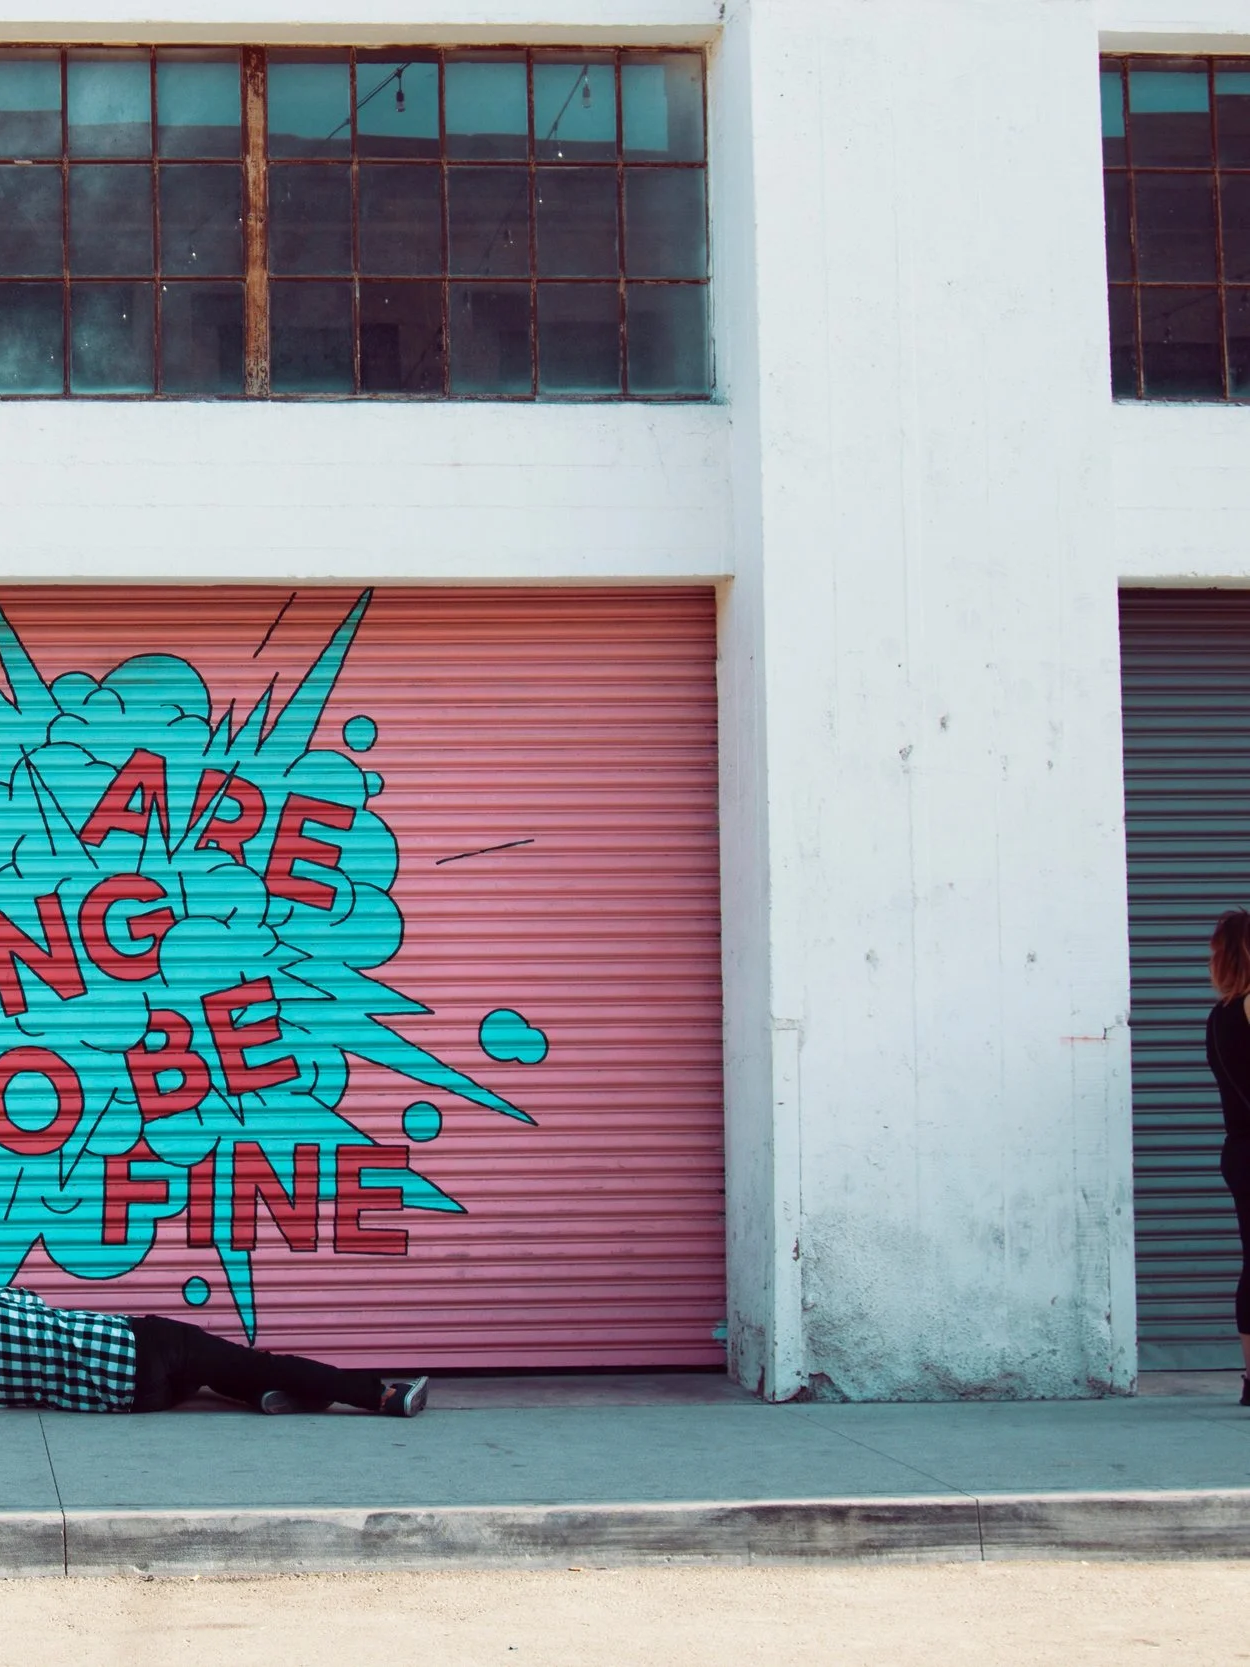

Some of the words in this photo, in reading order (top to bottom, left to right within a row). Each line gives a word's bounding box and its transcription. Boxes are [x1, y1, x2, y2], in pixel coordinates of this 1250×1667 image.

[81, 748, 358, 910] ARE
[125, 976, 301, 1123] BE
[103, 1142, 411, 1256] FINE
